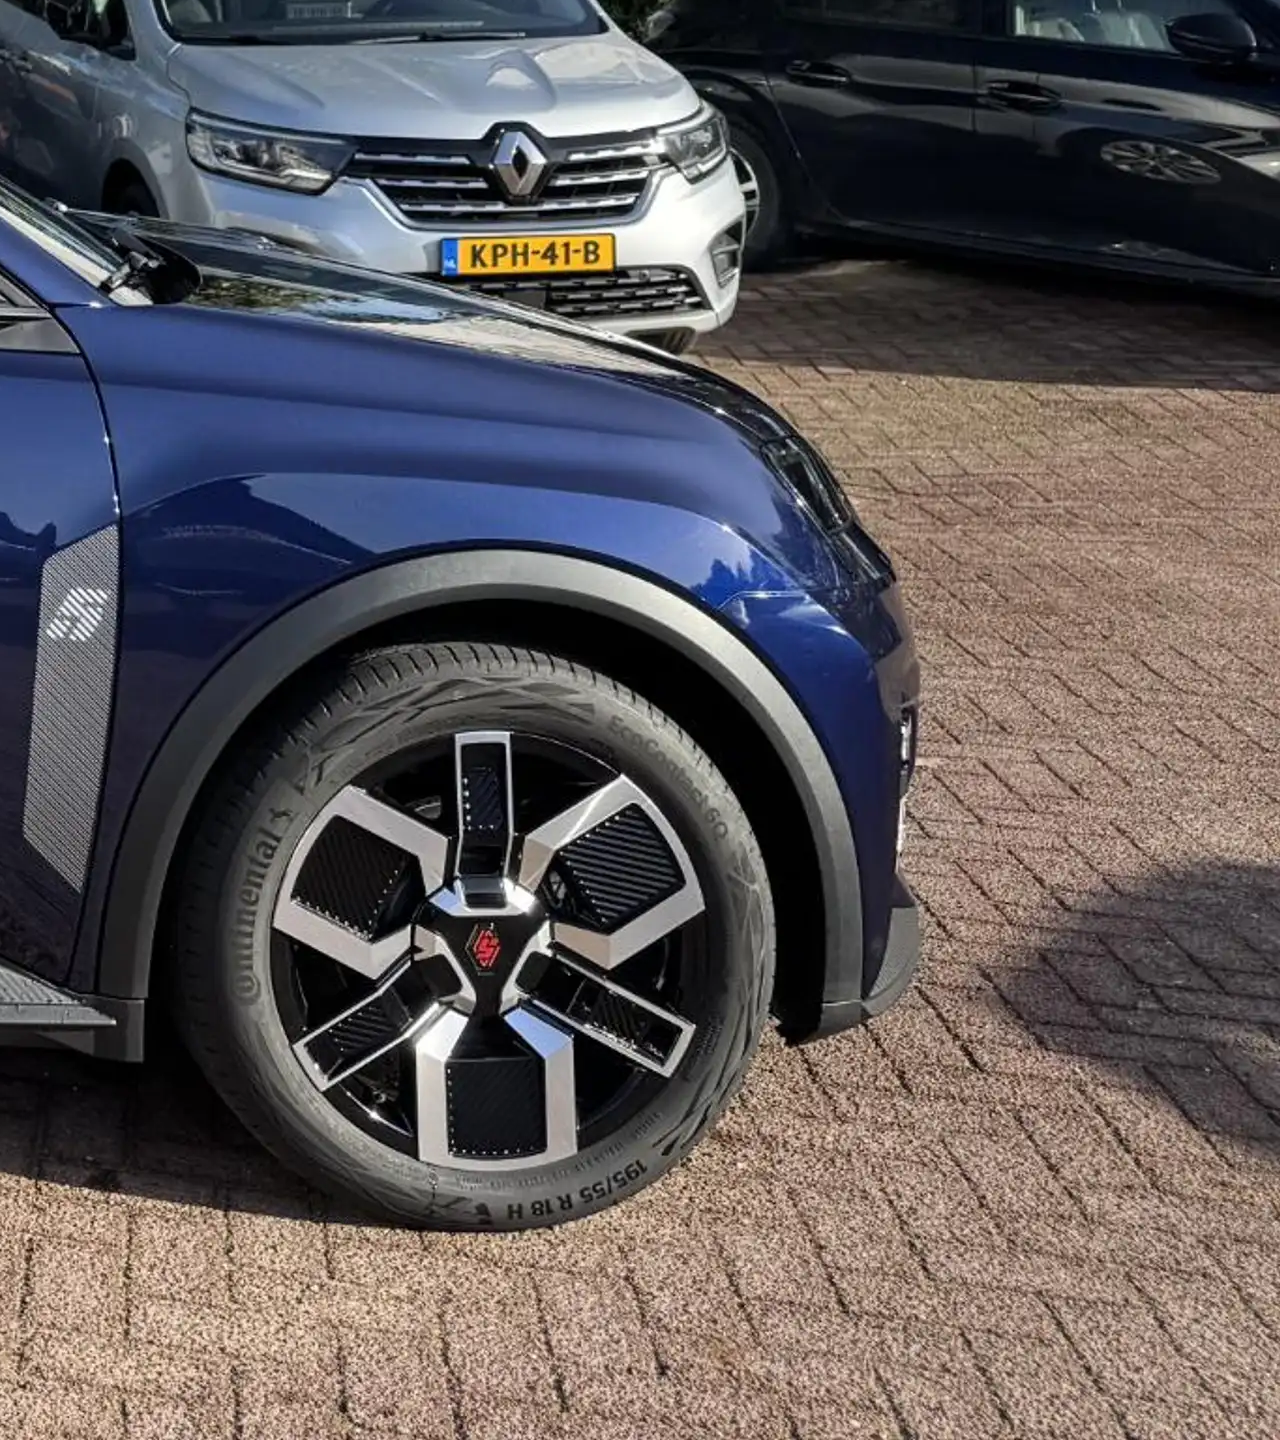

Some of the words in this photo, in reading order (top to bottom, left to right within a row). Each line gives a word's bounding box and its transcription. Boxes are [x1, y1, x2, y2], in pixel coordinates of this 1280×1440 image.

[470, 240, 600, 268] KPH-41-B
[580, 1159, 648, 1204] 195/55
[507, 1202, 523, 1220] H
[531, 1197, 554, 1216] 18
[557, 1193, 573, 1210] R
